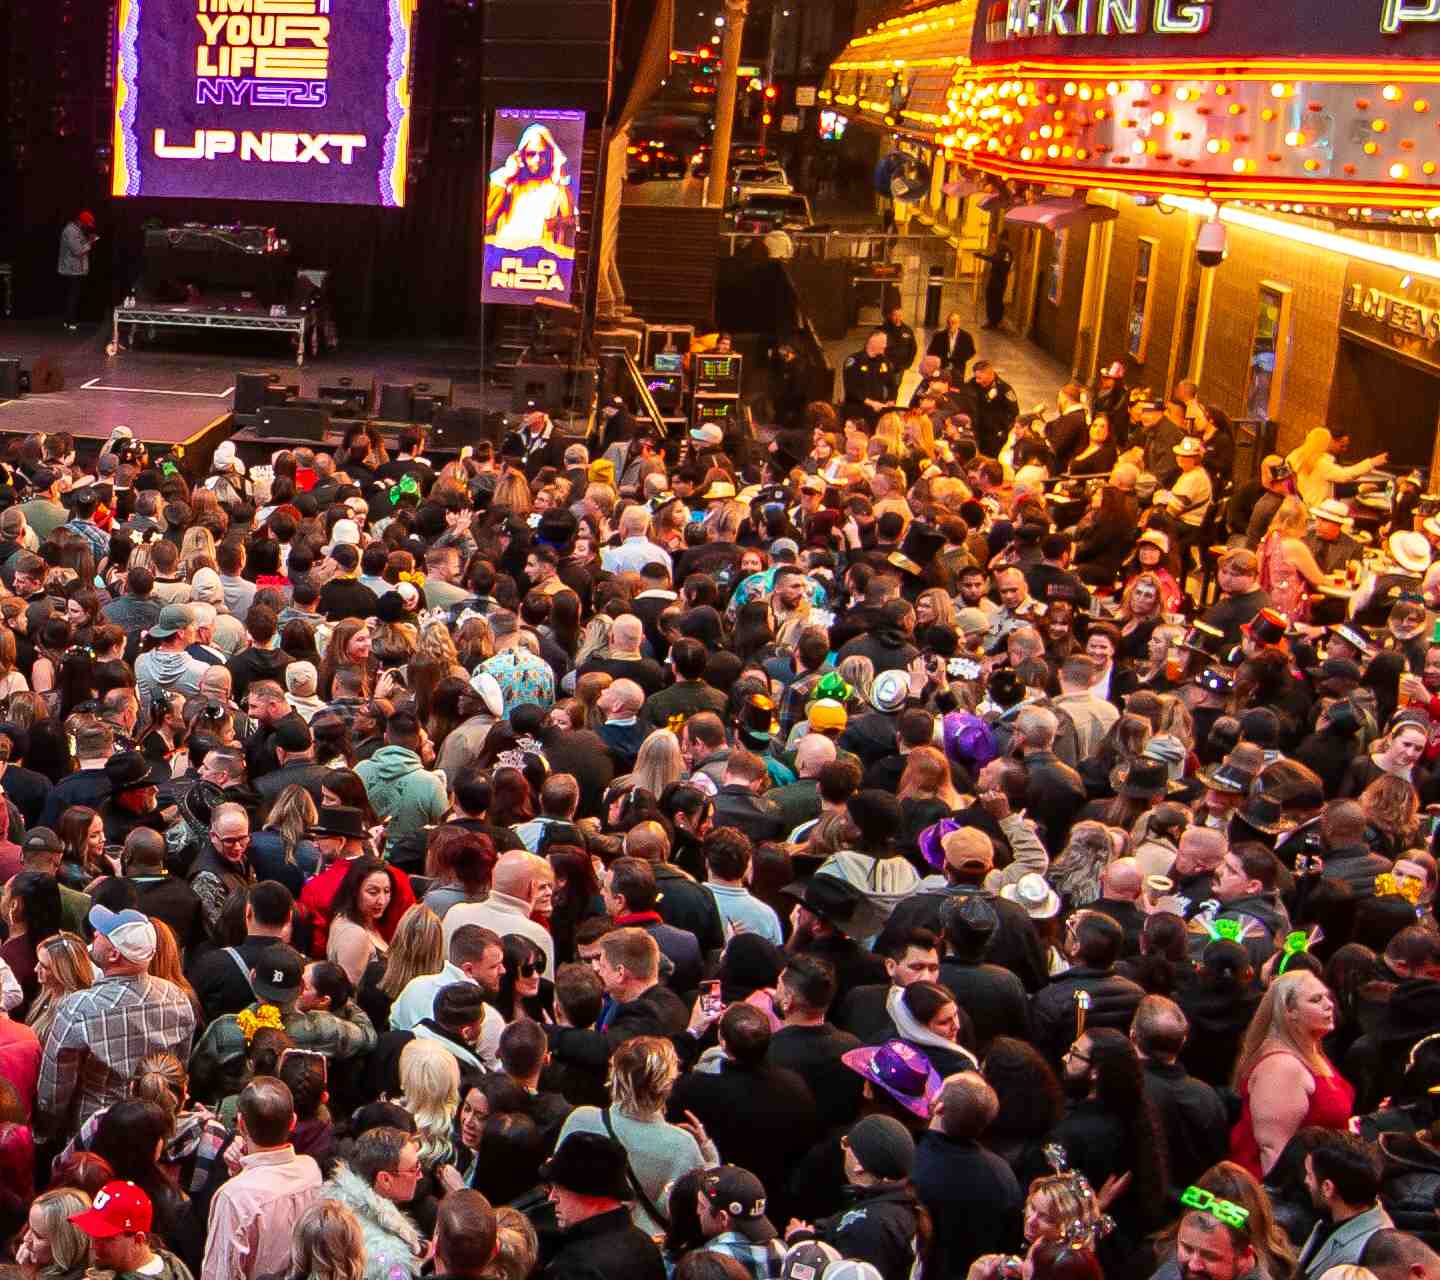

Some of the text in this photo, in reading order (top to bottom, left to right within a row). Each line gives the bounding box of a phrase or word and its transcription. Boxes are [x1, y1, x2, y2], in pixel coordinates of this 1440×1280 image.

[197, 14, 330, 48] YOUR
[196, 45, 329, 79] LIFE
[153, 127, 367, 165] UP NEXT
